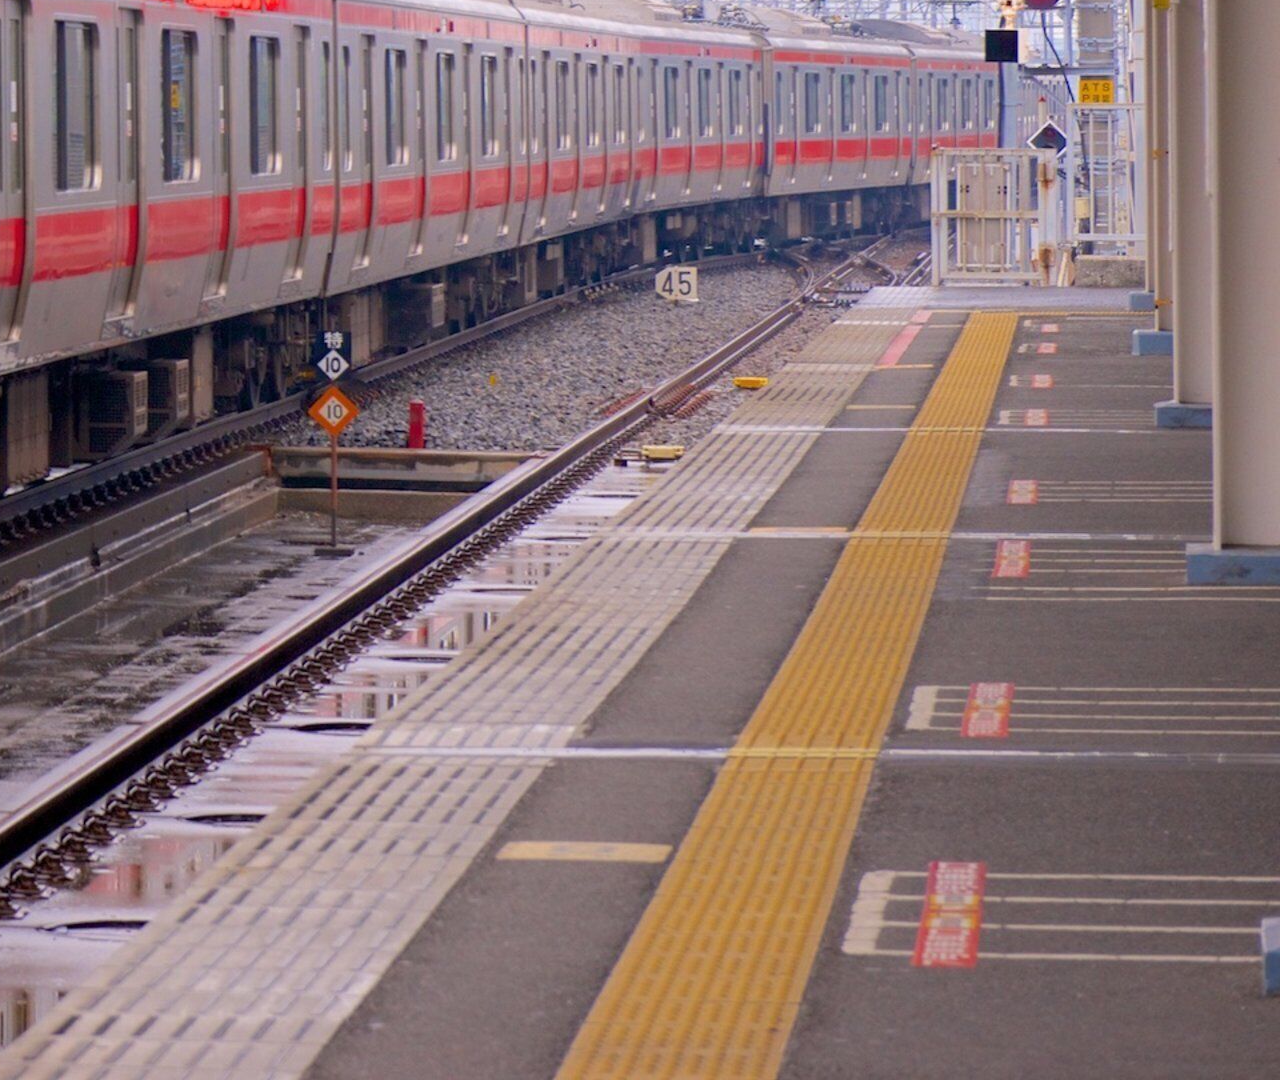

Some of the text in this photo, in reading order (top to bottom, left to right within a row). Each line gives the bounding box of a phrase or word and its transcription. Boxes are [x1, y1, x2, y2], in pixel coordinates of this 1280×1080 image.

[1082, 82, 1110, 92] ATS
[662, 271, 692, 296] 45
[323, 331, 344, 349] 特
[325, 357, 341, 373] 10
[327, 404, 343, 419] 10
